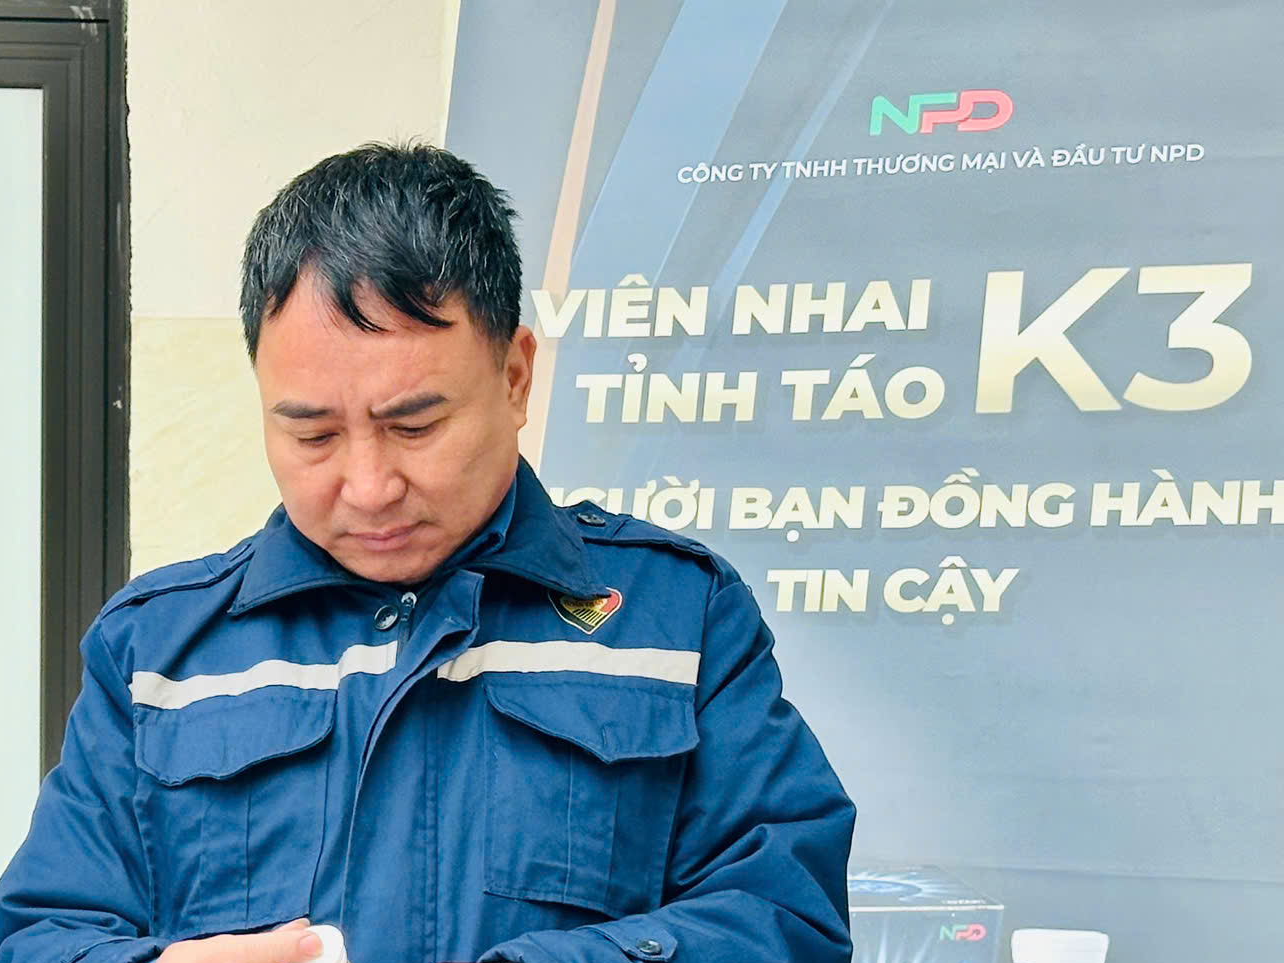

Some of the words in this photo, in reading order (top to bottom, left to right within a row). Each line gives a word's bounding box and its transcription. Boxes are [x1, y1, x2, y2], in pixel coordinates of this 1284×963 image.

[870, 89, 1013, 136] NPD
[677, 162, 743, 184] CÔNG
[749, 162, 778, 181] TY
[782, 159, 847, 179] TNHH
[853, 153, 955, 176] THƯƠNG
[961, 151, 1006, 174] MẠI
[1013, 147, 1045, 169] VÀ
[1111, 144, 1145, 165] TƯ
[1150, 144, 1205, 163] NPD
[531, 274, 709, 338] VIÊN
[731, 279, 932, 335] NHAI
[975, 263, 1253, 413] K3
[576, 353, 758, 424] TỈNH
[781, 353, 945, 421] TÁO
[548, 476, 715, 530] ƯỜI
[728, 486, 865, 542] BẠN
[877, 467, 1076, 529] ĐỒNG
[1090, 469, 1284, 527] HÀNH
[767, 569, 869, 612] TIN
[883, 556, 1020, 625] CẬY
